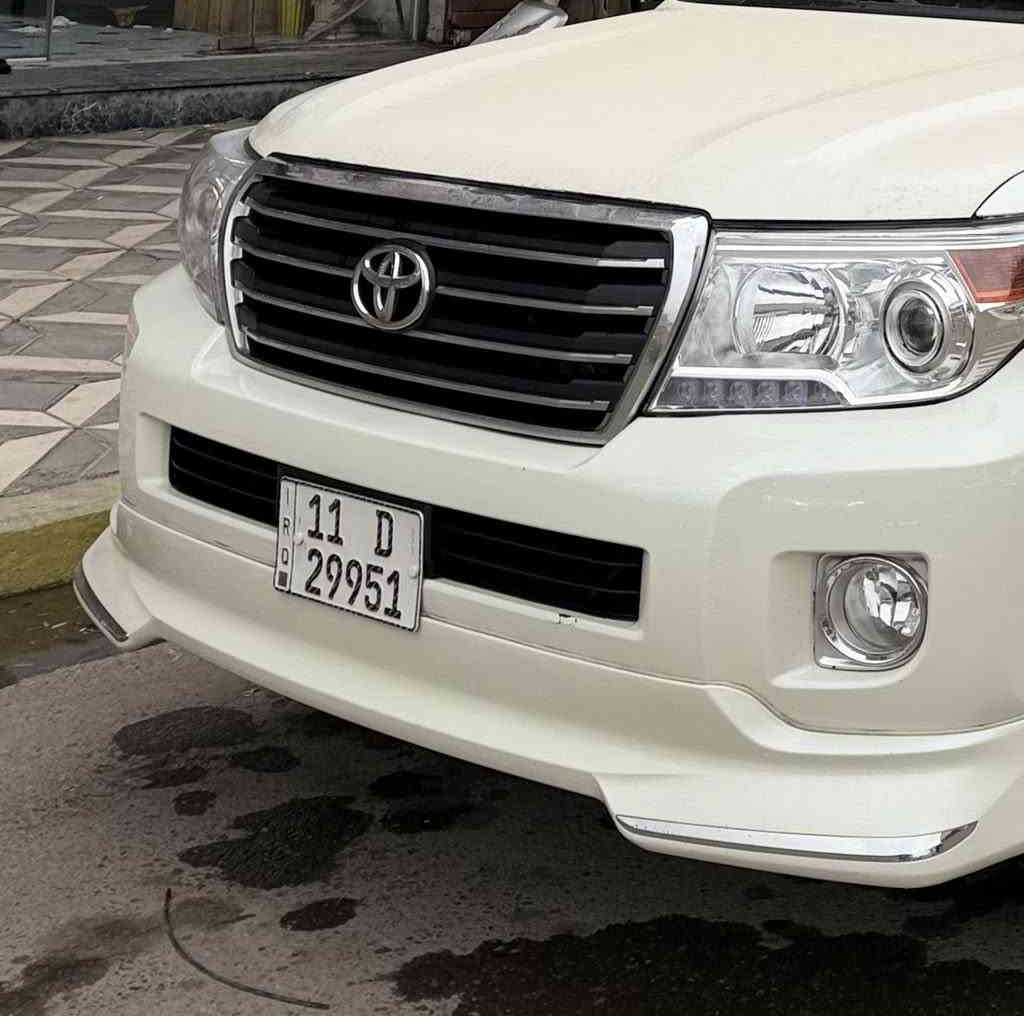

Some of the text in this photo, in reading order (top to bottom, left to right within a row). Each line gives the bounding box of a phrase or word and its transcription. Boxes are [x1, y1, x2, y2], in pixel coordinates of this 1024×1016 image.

[307, 493, 394, 558] 11 D
[305, 547, 402, 620] 29951
